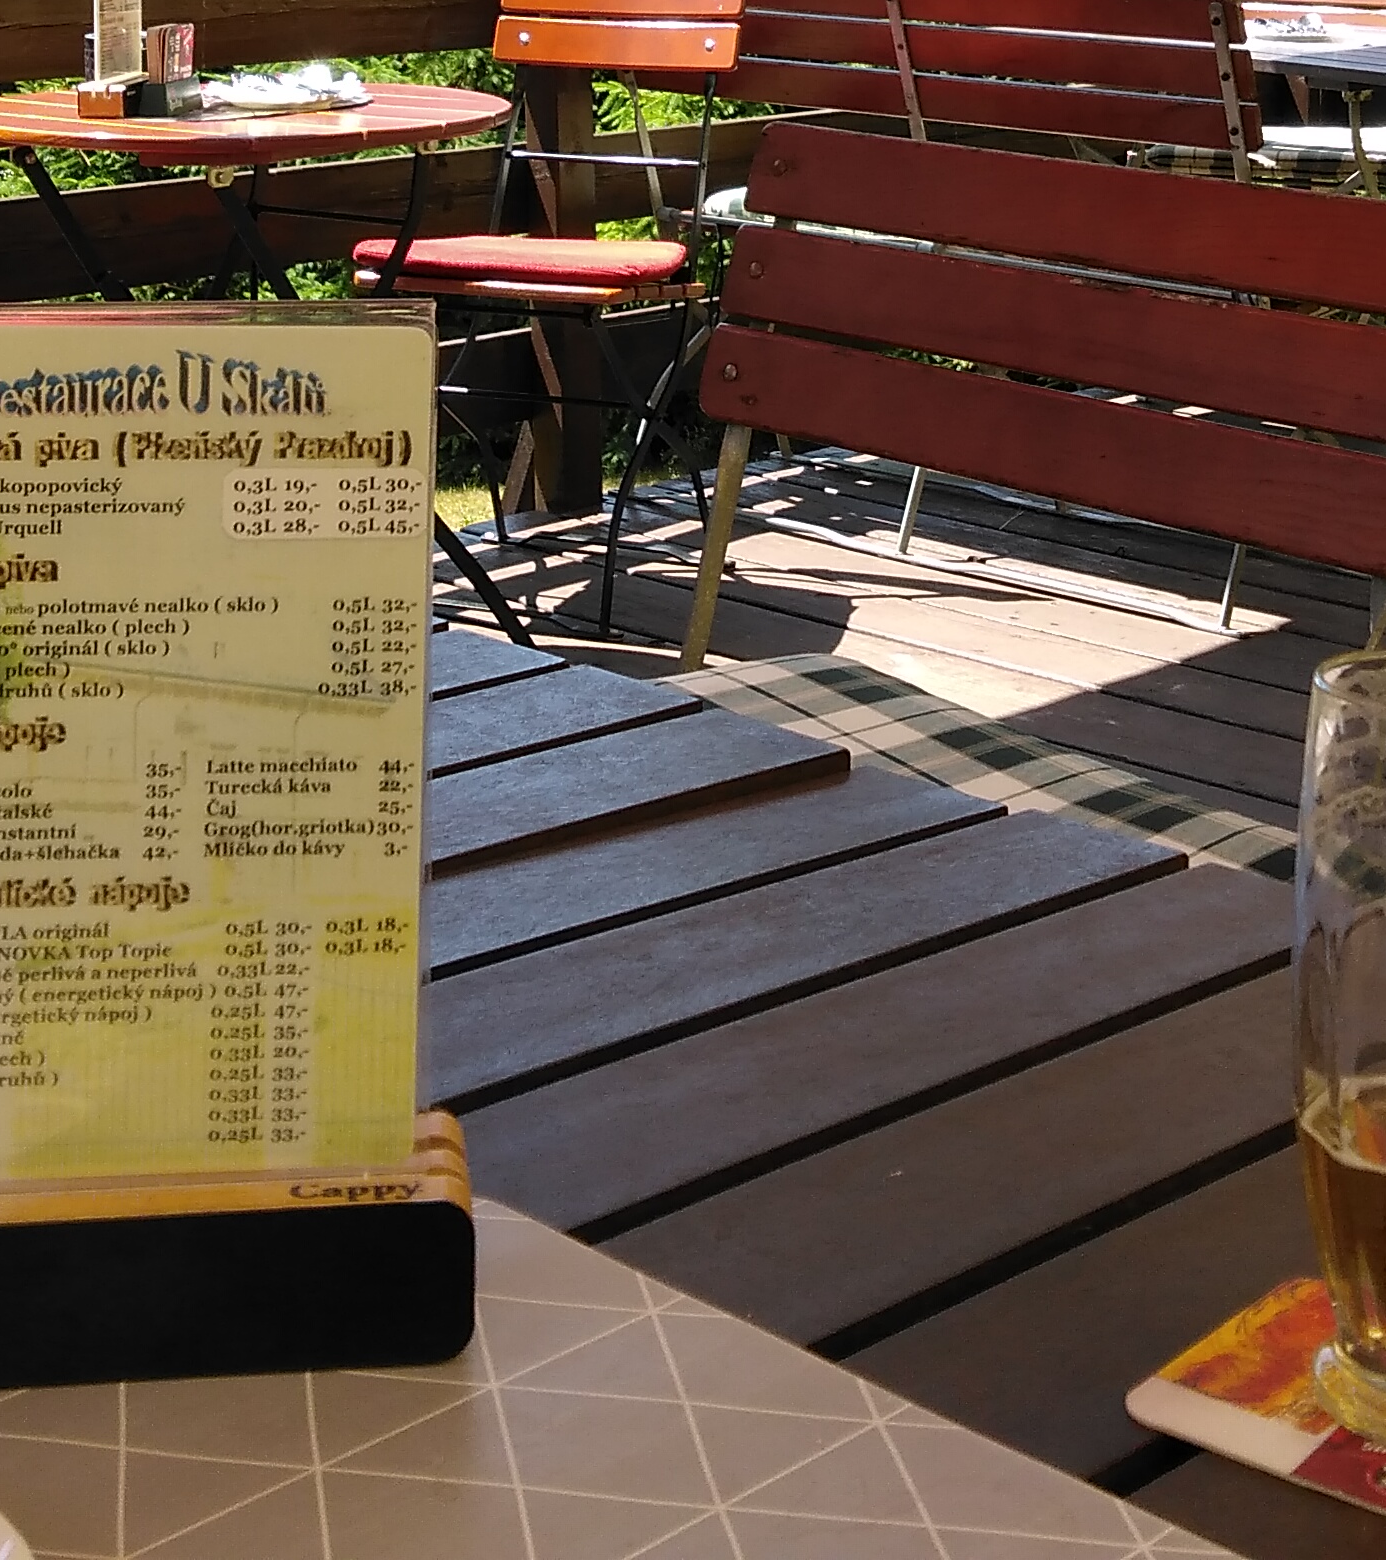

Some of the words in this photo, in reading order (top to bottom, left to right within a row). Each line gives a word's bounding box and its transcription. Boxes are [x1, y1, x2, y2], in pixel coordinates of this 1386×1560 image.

[175, 348, 215, 415] U
[35, 432, 100, 468] piva
[26, 497, 186, 517] nepasterizovaný
[5, 602, 34, 615] nebo
[38, 598, 139, 616] polotmavé
[145, 597, 209, 613] nealko
[42, 620, 107, 635] nealko
[23, 640, 99, 658] originál
[206, 759, 255, 774] Latte
[260, 758, 357, 774] macchiato
[205, 779, 283, 796] Turecká
[288, 778, 331, 794] káva
[205, 798, 237, 818] Čaj
[273, 842, 297, 856] do
[302, 840, 345, 858] kávy
[33, 922, 110, 942] originál
[76, 945, 113, 962] Top
[118, 943, 173, 961] Topic
[18, 966, 85, 986] perlivá
[91, 970, 100, 980] a
[106, 962, 197, 980] neperlivá
[33, 984, 144, 1004] energetický
[288, 1181, 425, 1203] Cappy
